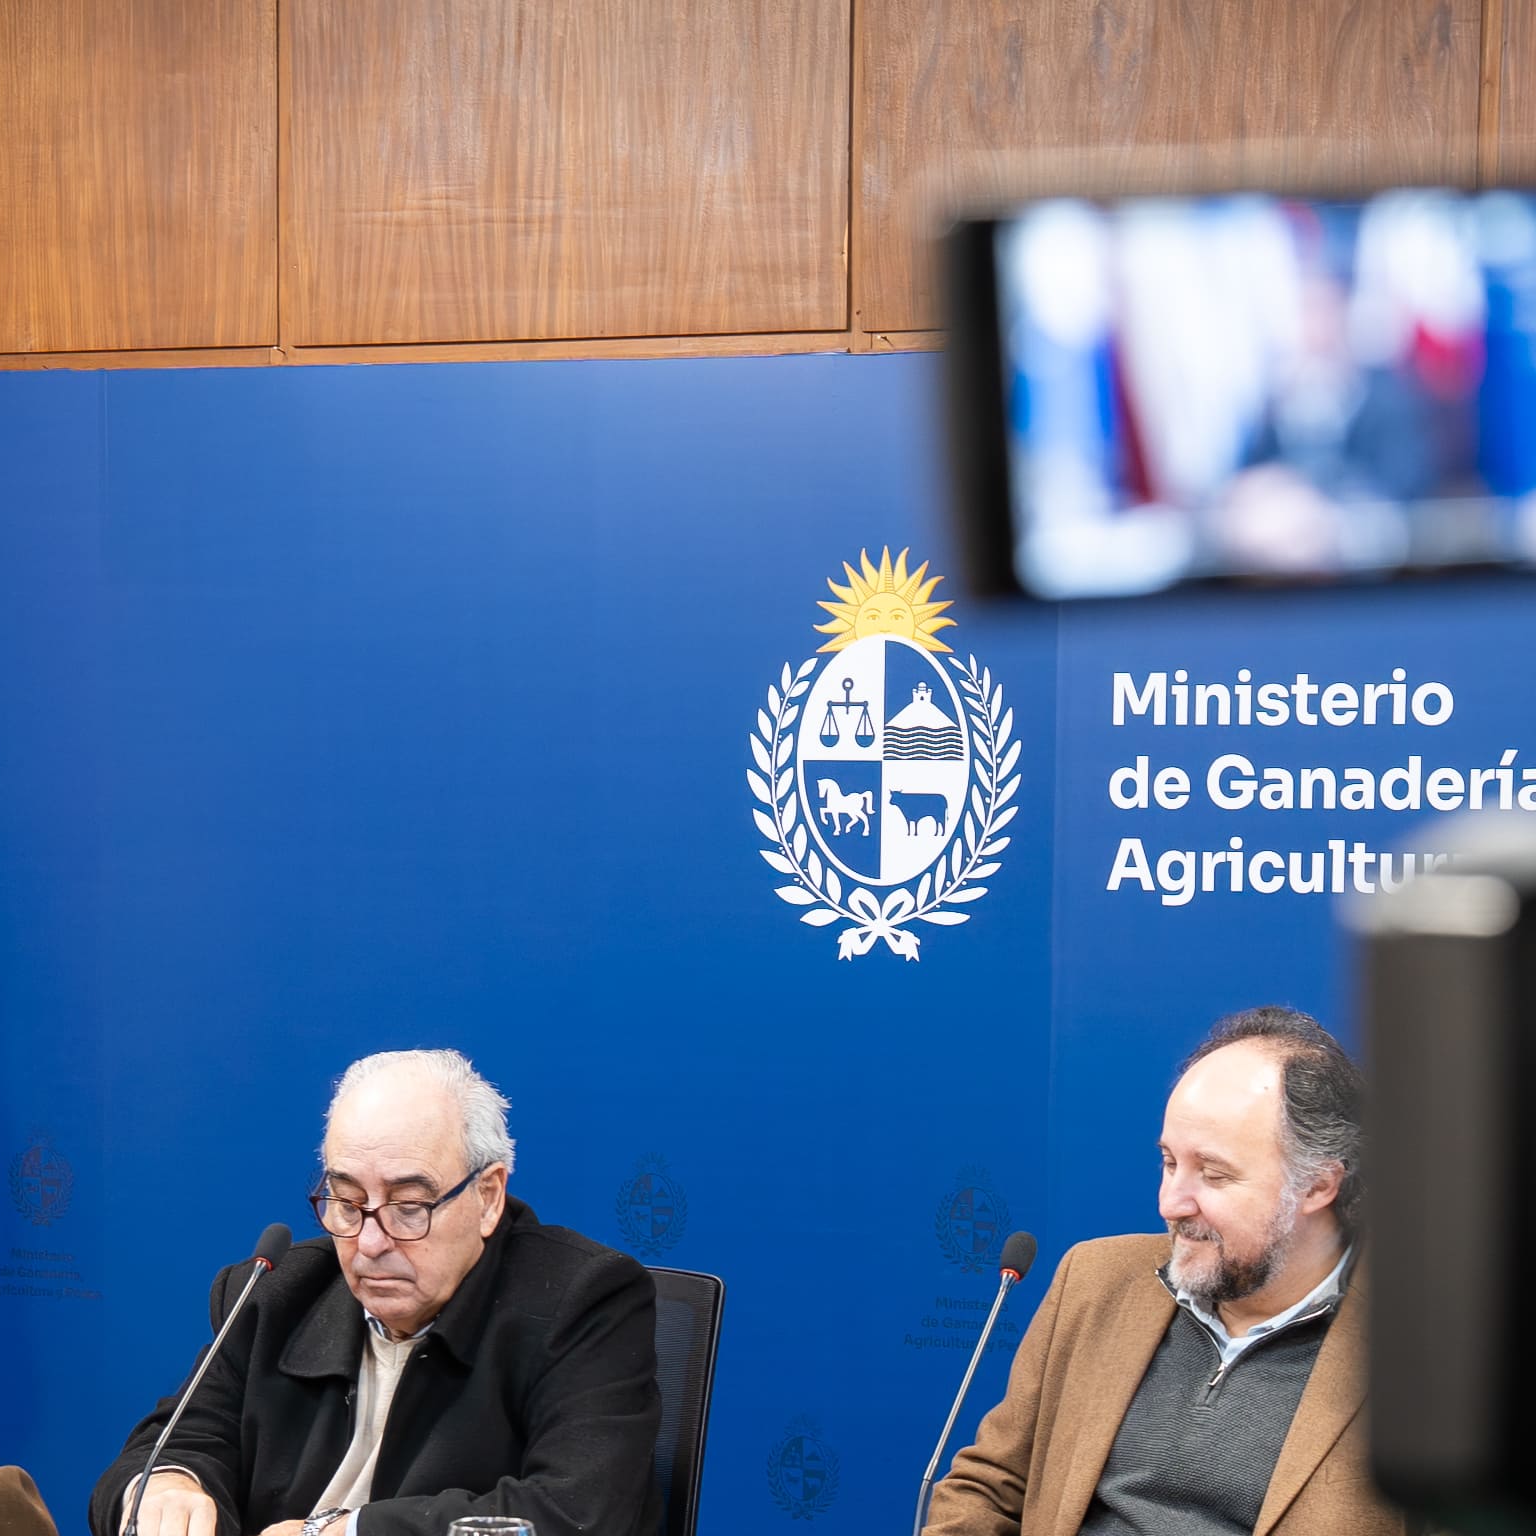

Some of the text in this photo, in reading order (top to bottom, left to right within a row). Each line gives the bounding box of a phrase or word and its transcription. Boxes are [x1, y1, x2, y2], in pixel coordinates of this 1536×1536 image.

[1112, 668, 1454, 727] Ministerio
[1108, 755, 1190, 810] de
[1107, 837, 1450, 906] Agricultur
